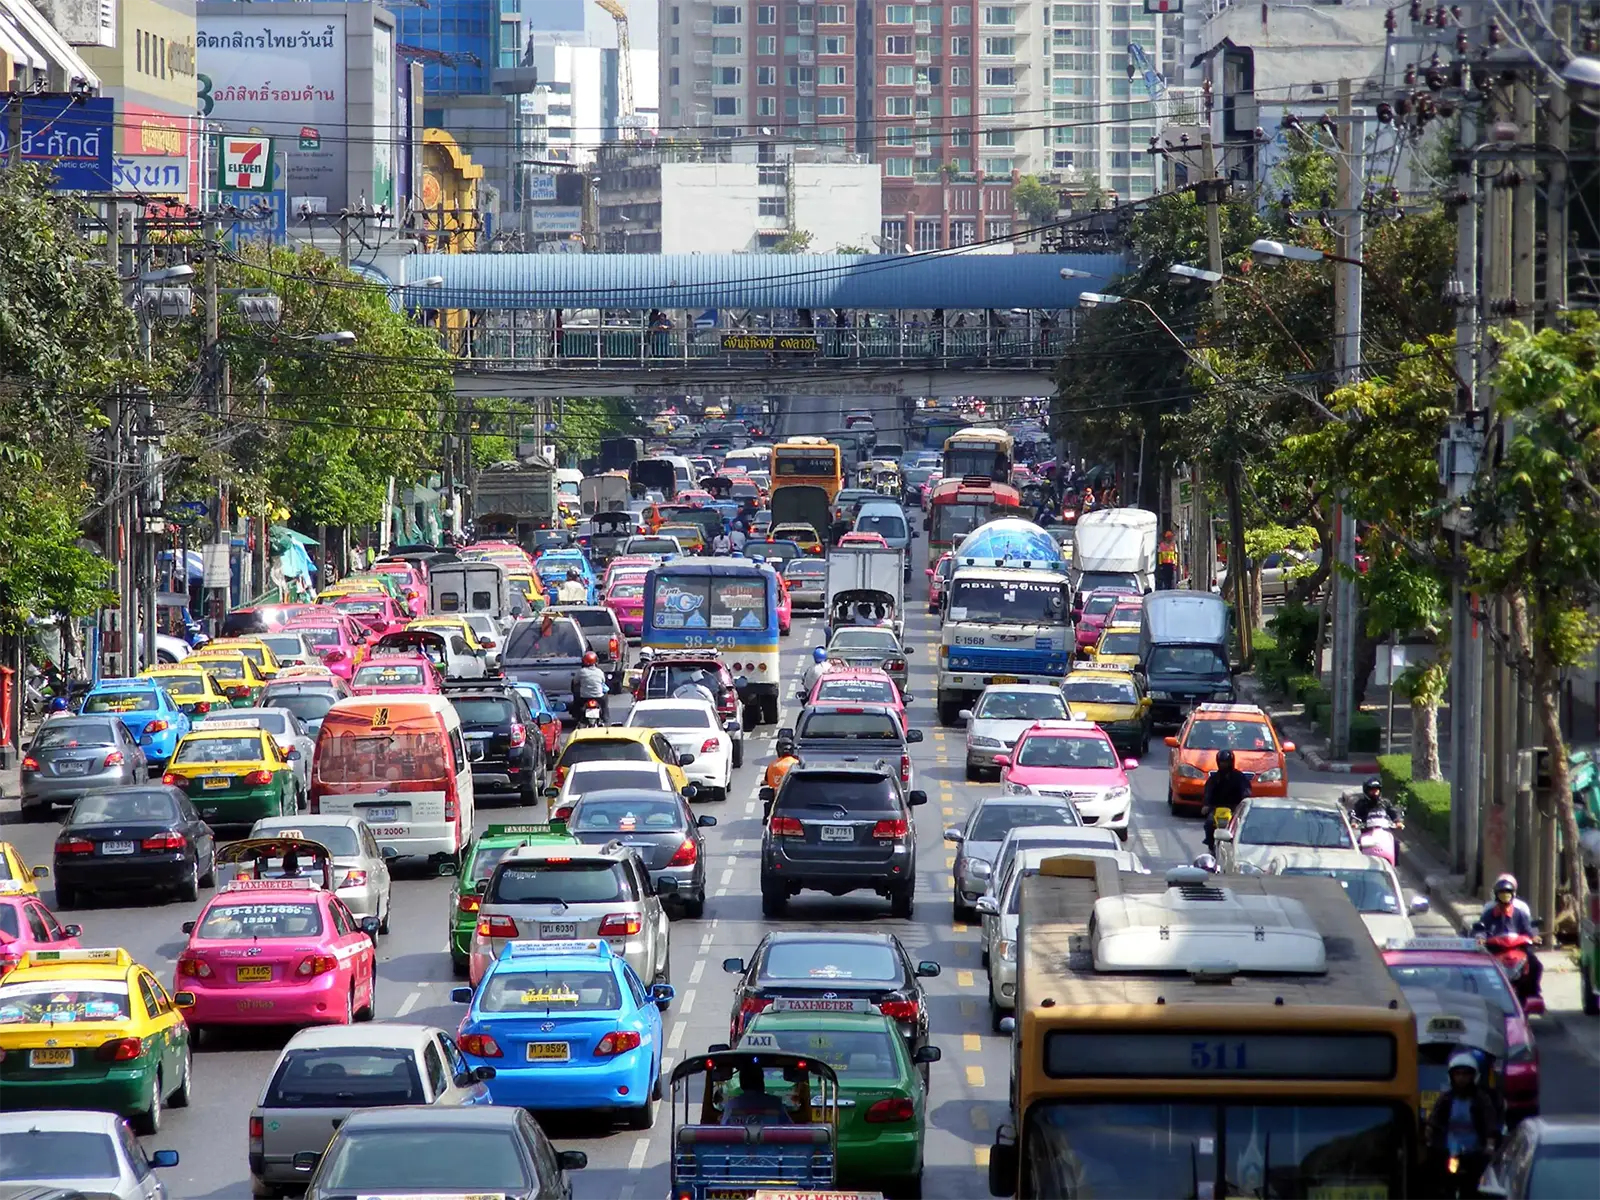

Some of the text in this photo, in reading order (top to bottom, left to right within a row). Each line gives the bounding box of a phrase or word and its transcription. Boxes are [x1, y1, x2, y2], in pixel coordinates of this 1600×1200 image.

[214, 81, 335, 101] อภิสิทธิ์รอบด้าน
[955, 635, 985, 646] E-1568
[556, 925, 574, 933] 6030
[788, 1000, 854, 1011] TAXI-METER
[747, 1036, 771, 1046] TAXI
[545, 1044, 567, 1054] 9592
[1190, 1042, 1247, 1070] 511
